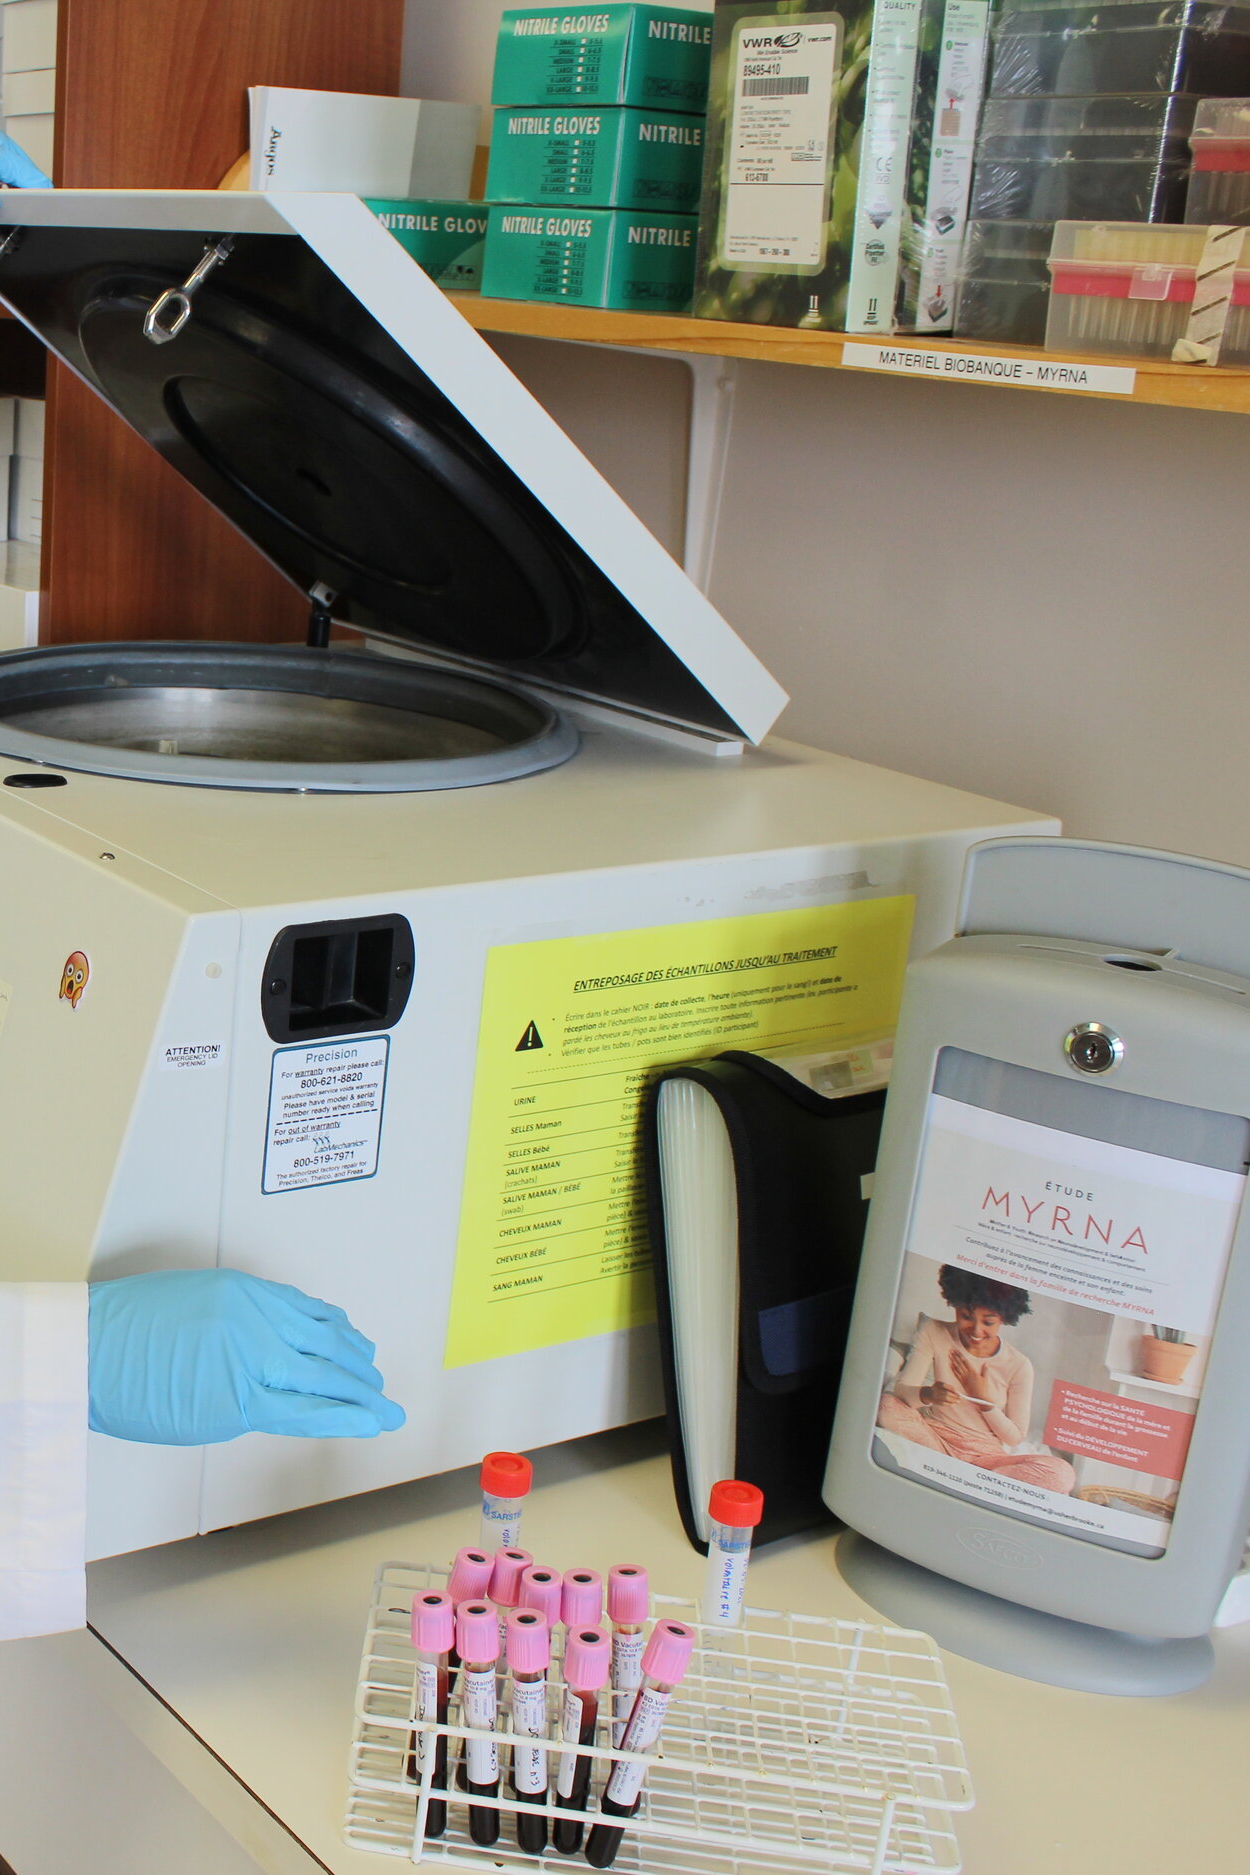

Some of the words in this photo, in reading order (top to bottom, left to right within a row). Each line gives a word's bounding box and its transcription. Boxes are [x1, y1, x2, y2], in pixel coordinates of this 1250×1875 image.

[514, 17, 558, 36] NITRILE
[561, 14, 609, 34] GLOVES
[648, 20, 710, 44] NITRILE
[743, 37, 773, 48] VWR
[508, 117, 550, 134] NITRILE
[553, 116, 600, 135] GLOVES
[639, 124, 701, 145] NITRILE
[378, 213, 438, 231] NITRILE
[502, 216, 543, 234] NITRILE
[546, 218, 591, 237] GLOVES
[628, 226, 691, 247] NITRILE
[879, 351, 940, 370] MATERIEL
[945, 357, 1022, 378] BIOBANQUE
[1037, 366, 1088, 384] MYRNA
[573, 971, 643, 991] ENTREPOSAGE
[646, 969, 663, 981] DES
[665, 959, 733, 978] ÉCHANTILLONS
[782, 945, 837, 962] TRAITEMENT
[654, 1000, 669, 1009] date
[612, 1039, 630, 1049] tubes
[637, 1037, 651, 1047] pots
[652, 1034, 666, 1043] sont
[668, 1032, 681, 1040] bien
[165, 1044, 220, 1056] ATTENTION!
[167, 1053, 205, 1062] EMERGENCY
[306, 1047, 357, 1064] Precision
[177, 1059, 205, 1067] OPENING
[281, 1070, 293, 1079] For
[295, 1067, 323, 1078] warranty
[325, 1064, 345, 1074] repair
[347, 1061, 368, 1071] please
[300, 1072, 362, 1089] 800-621-8820
[281, 1090, 317, 1100] unauthorized
[318, 1086, 338, 1095] service
[339, 1084, 353, 1092] voids
[355, 1081, 378, 1091] warranty
[282, 1108, 308, 1119] number
[311, 1105, 330, 1115] ready
[332, 1102, 350, 1111] when
[351, 1098, 374, 1110] calling
[283, 1099, 306, 1110] Please
[309, 1097, 325, 1106] have
[327, 1093, 347, 1104] model
[356, 1090, 375, 1099] serial
[513, 1095, 536, 1106] URINE
[274, 1127, 286, 1136] For
[287, 1126, 299, 1135] out
[301, 1125, 308, 1133] of
[310, 1120, 340, 1132] warranty
[510, 1123, 533, 1134] SELLES
[535, 1119, 561, 1130] Maman
[273, 1137, 293, 1147] repair
[293, 1150, 354, 1168] 800-519-7971
[507, 1147, 530, 1158] SELLES
[277, 1172, 287, 1180] The
[288, 1168, 319, 1178] authorized
[320, 1164, 339, 1174] factory
[341, 1161, 357, 1170] repair
[505, 1165, 529, 1176] SALIVE
[531, 1160, 560, 1171] MAMAN
[502, 1193, 525, 1204] SALIVE
[527, 1187, 556, 1199] MAMAN
[1045, 1181, 1094, 1201] ÉTUDE
[499, 1224, 531, 1237] CHEVEUX
[532, 1218, 561, 1230] MAMAN
[982, 1186, 1148, 1254] MYRNA
[495, 1251, 527, 1264] CHEVEUX
[493, 1281, 512, 1291] SANG
[514, 1275, 542, 1286] MAMAN
[1122, 1302, 1155, 1315] MYRNA
